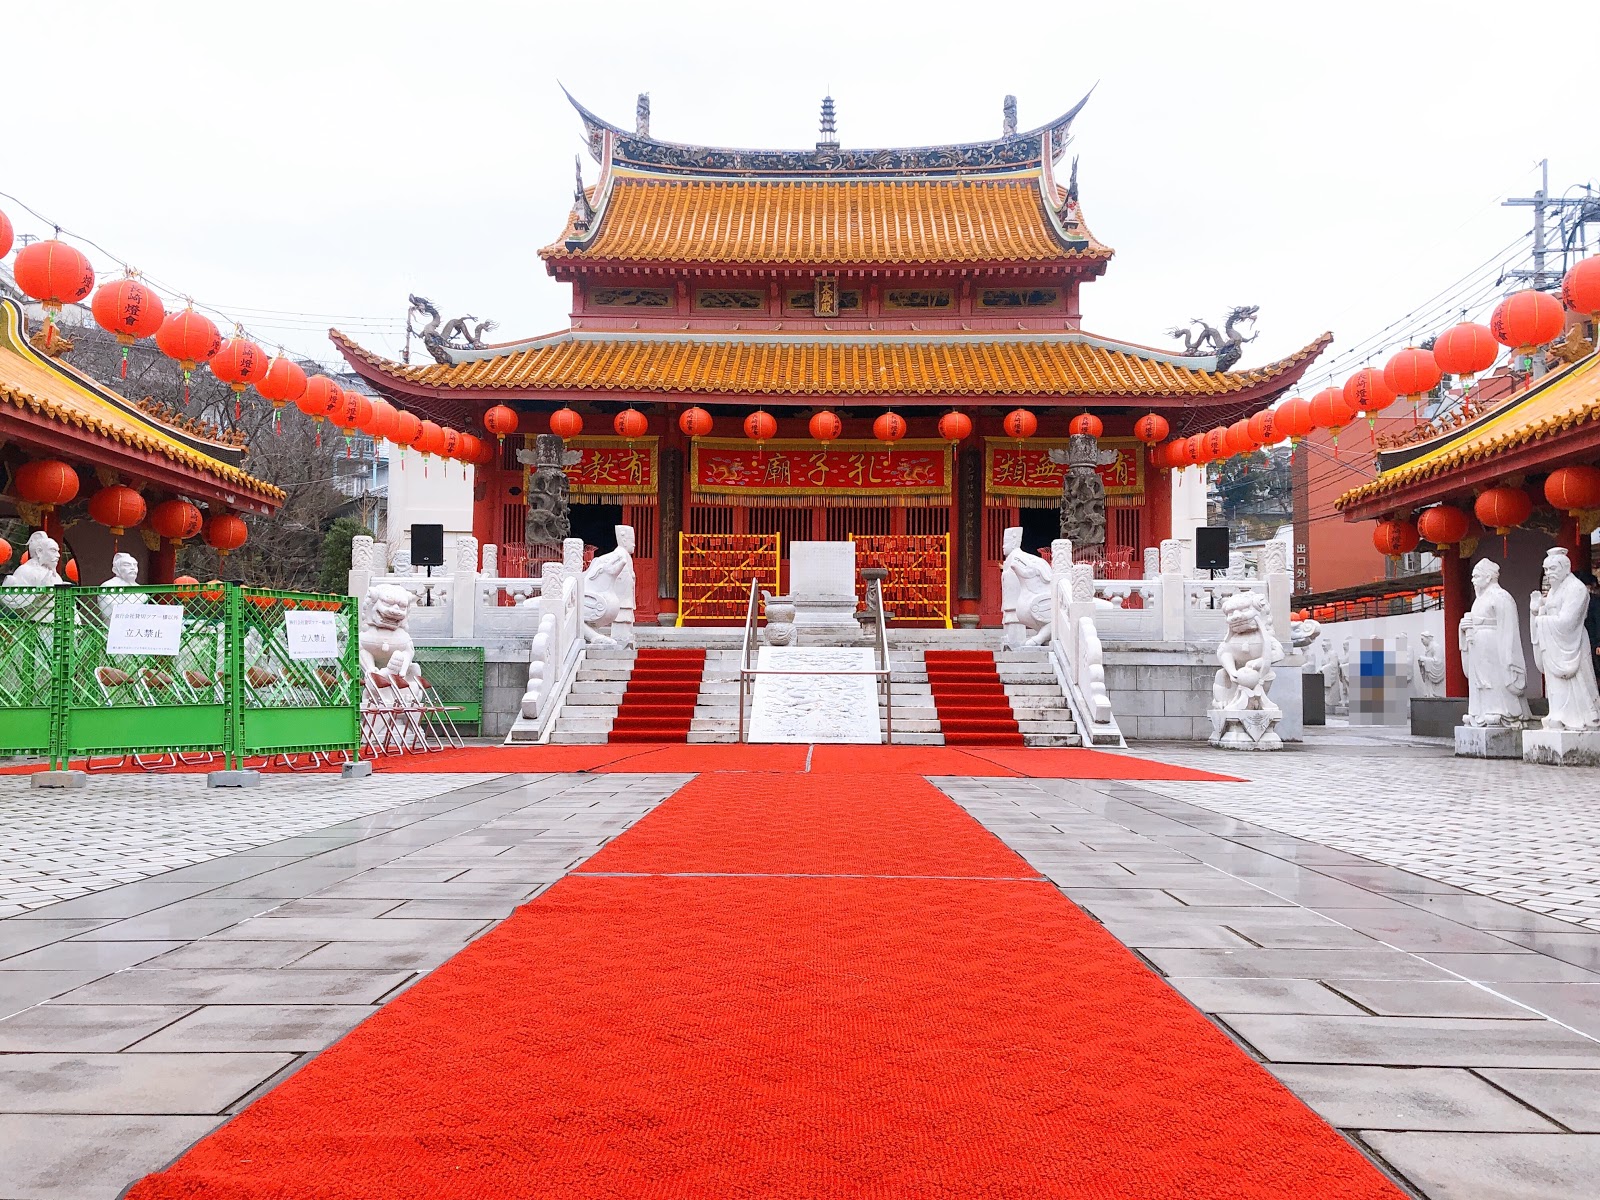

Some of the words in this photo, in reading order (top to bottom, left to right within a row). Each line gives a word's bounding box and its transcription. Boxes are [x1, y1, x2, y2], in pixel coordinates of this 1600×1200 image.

[1296, 543, 1307, 590] 出口外科
[125, 628, 163, 638] 立入禁止
[300, 633, 327, 643] 立入禁止
